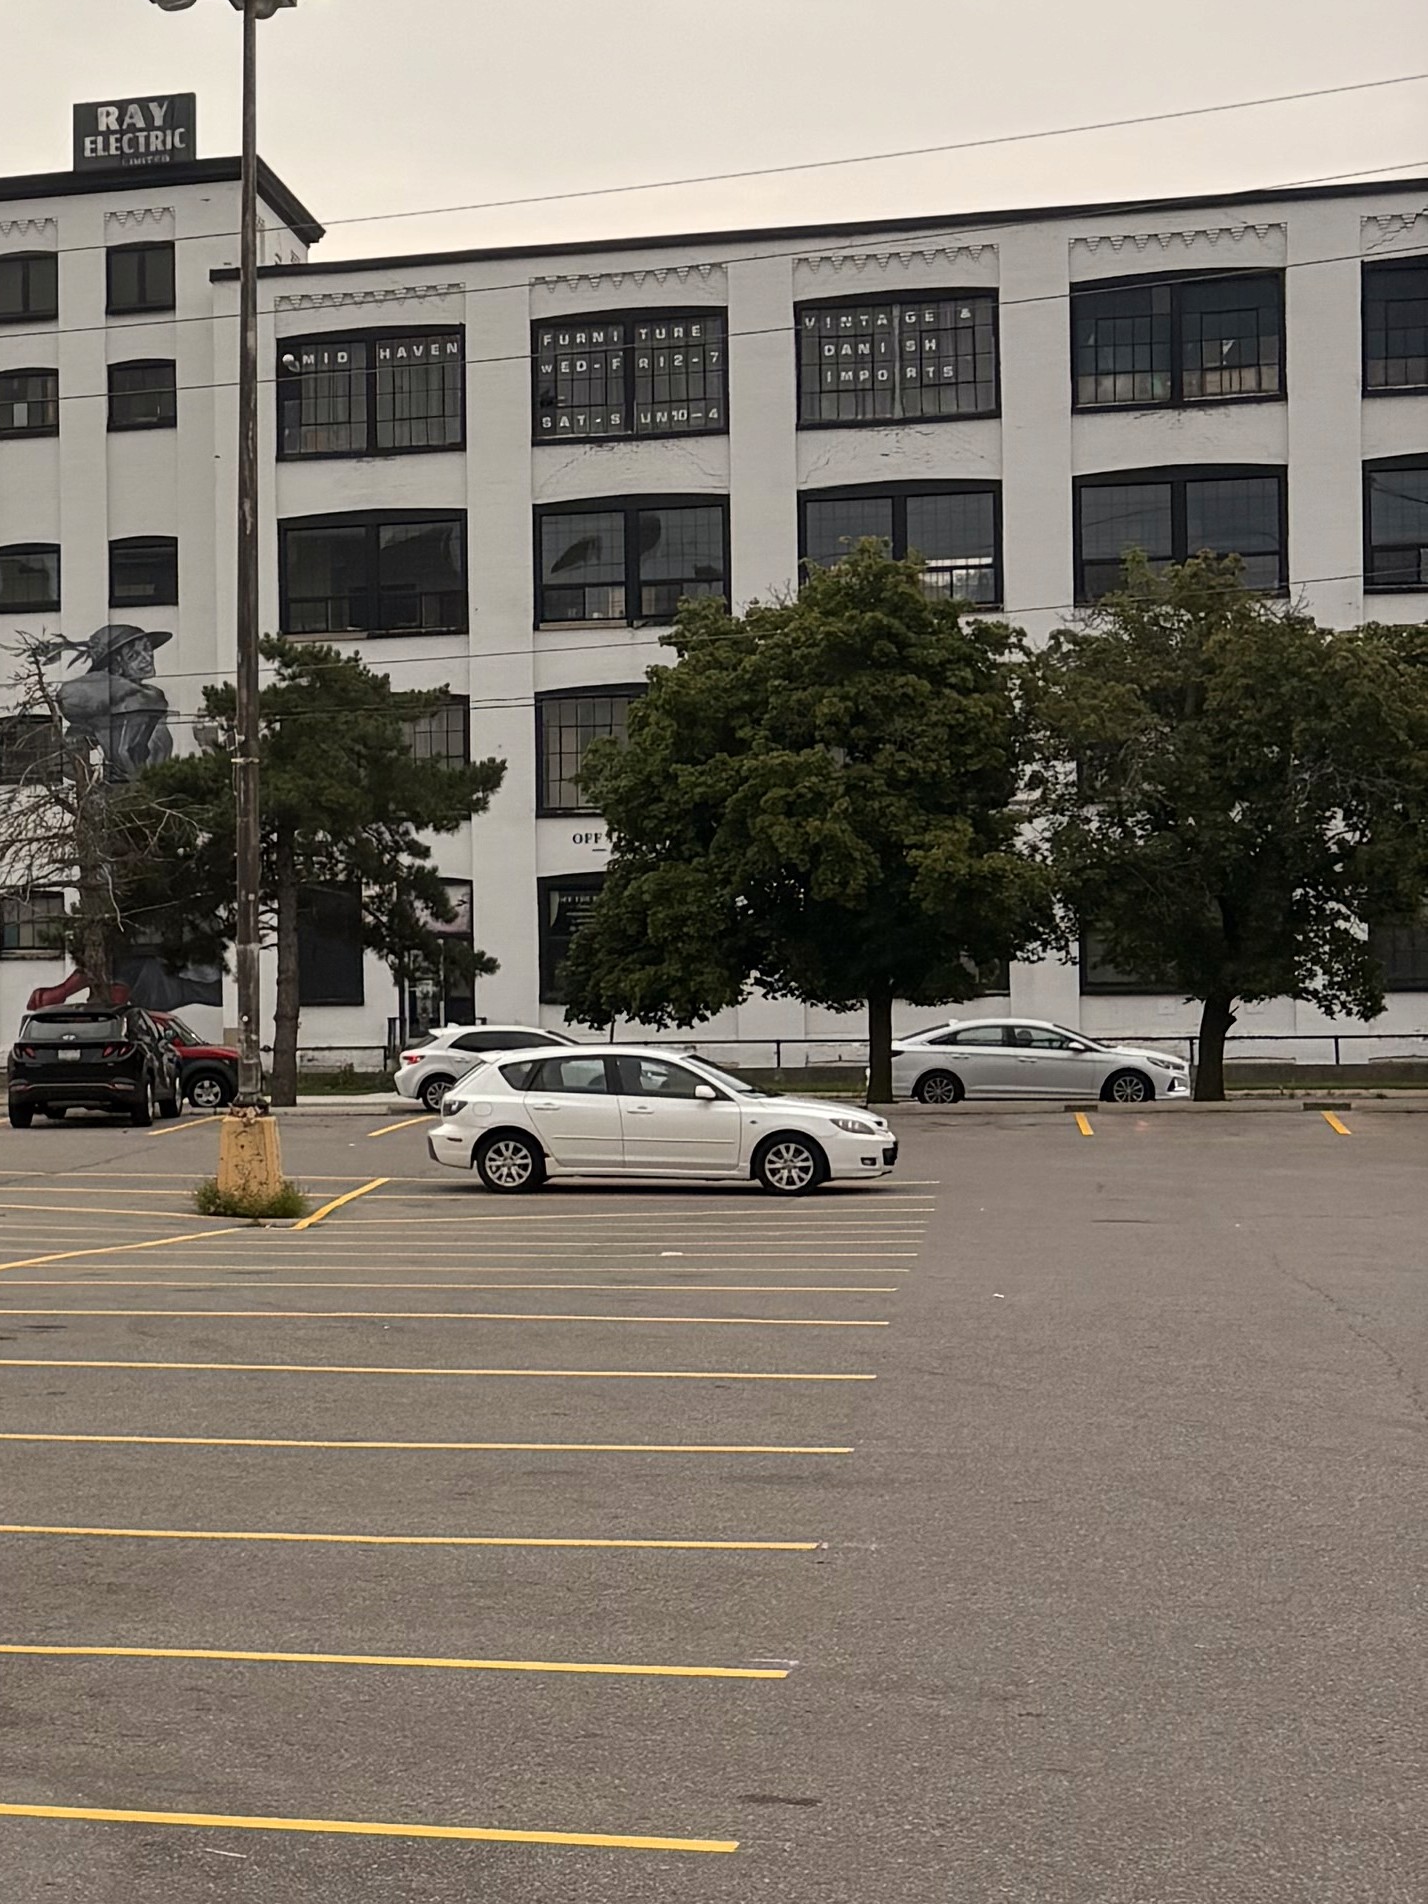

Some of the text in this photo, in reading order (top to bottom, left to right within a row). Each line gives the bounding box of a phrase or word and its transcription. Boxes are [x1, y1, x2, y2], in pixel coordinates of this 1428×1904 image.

[97, 100, 169, 131] RAY
[84, 127, 186, 158] ELECTRIC
[121, 154, 170, 167] LIMITED
[302, 342, 458, 365] MID HAVEN
